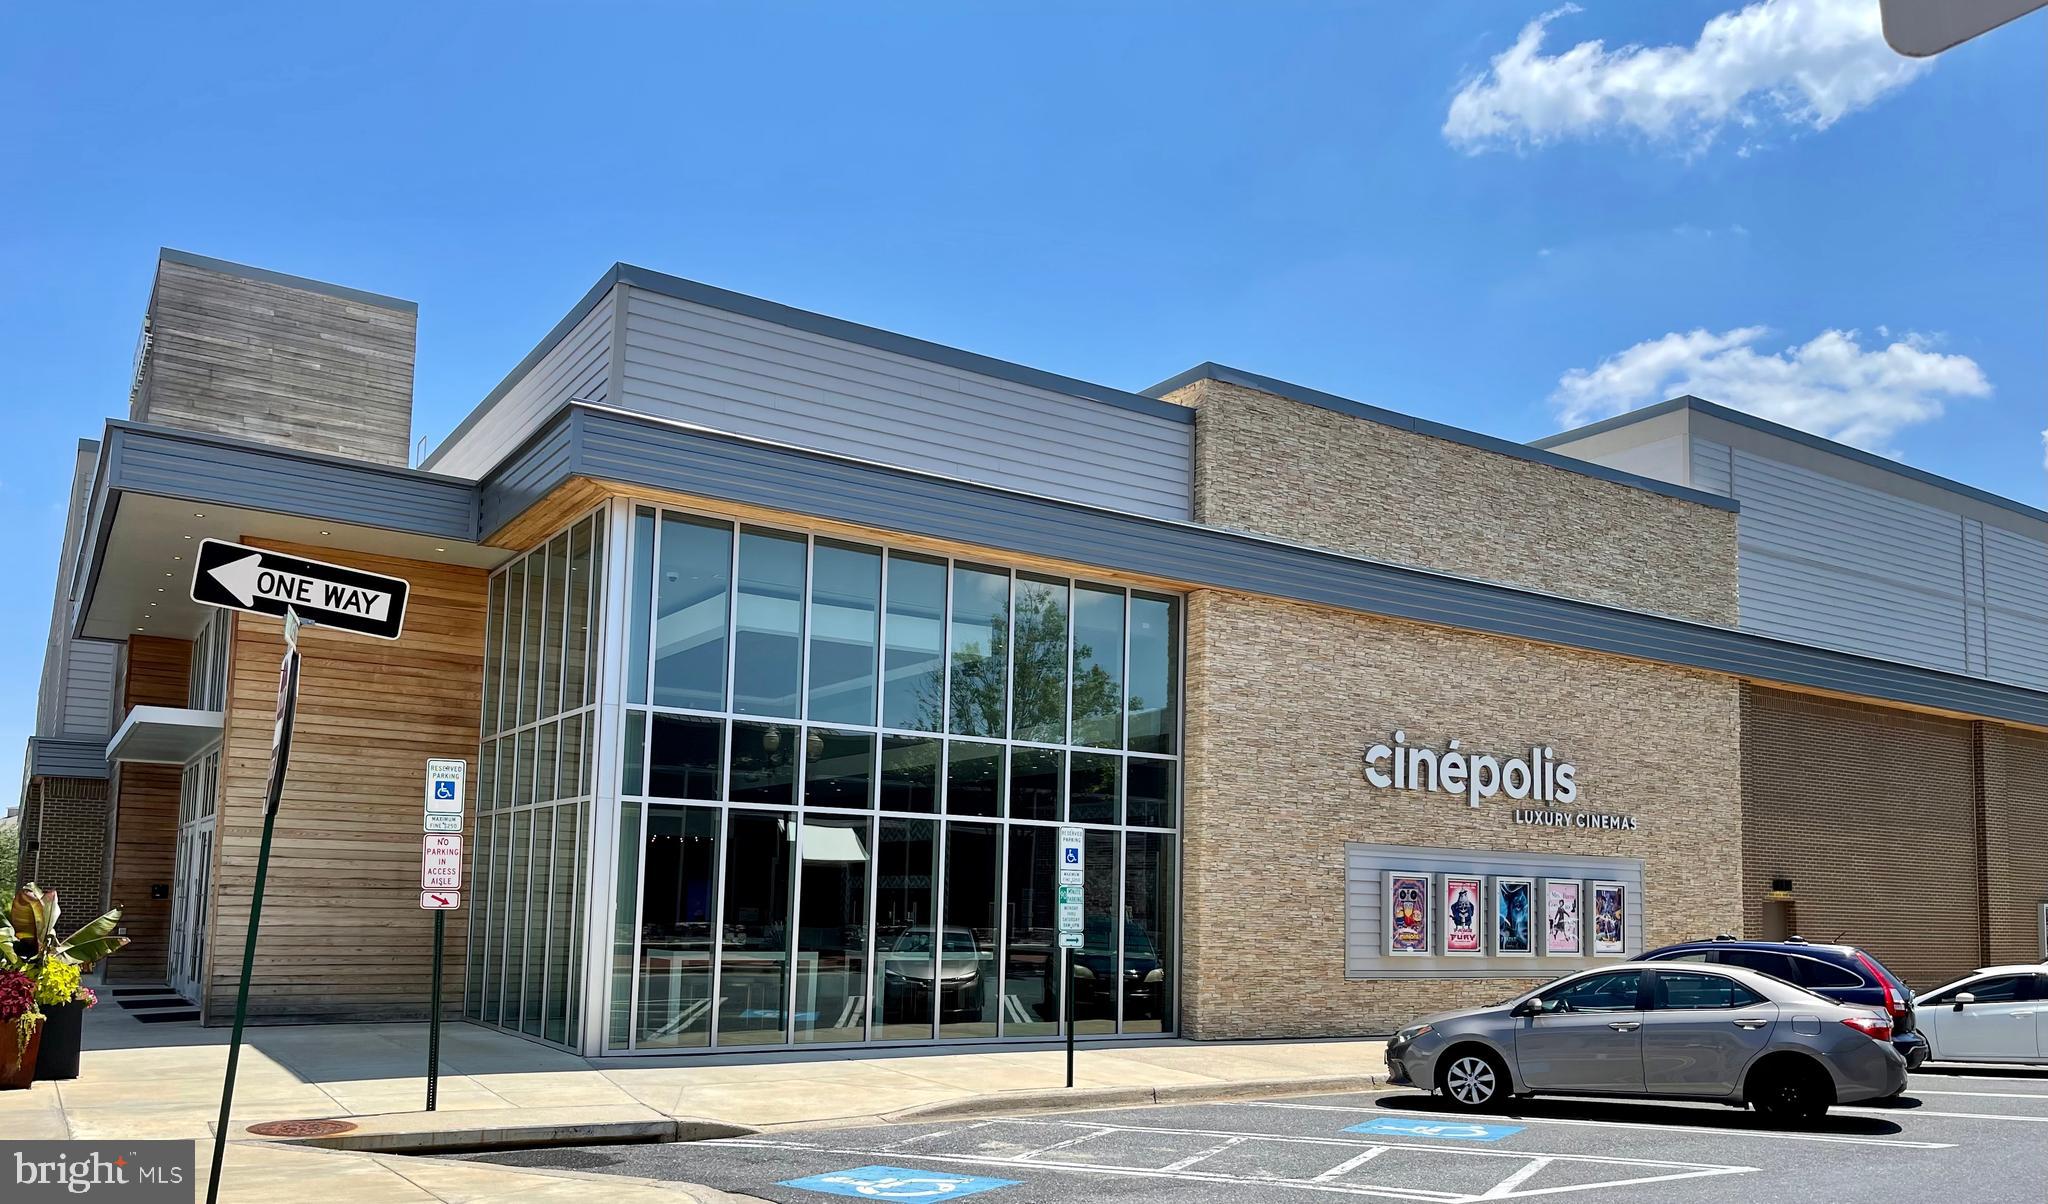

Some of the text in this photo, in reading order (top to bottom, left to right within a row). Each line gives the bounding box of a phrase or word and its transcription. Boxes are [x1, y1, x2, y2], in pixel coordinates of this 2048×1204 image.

[257, 571, 380, 615] ONE WAY
[430, 765, 462, 773] RESERVED
[1364, 730, 1577, 808] cinépolis
[1514, 809, 1638, 831] LUXURY CINEMAS
[437, 838, 449, 846] NO
[1450, 933, 1476, 941] FURY
